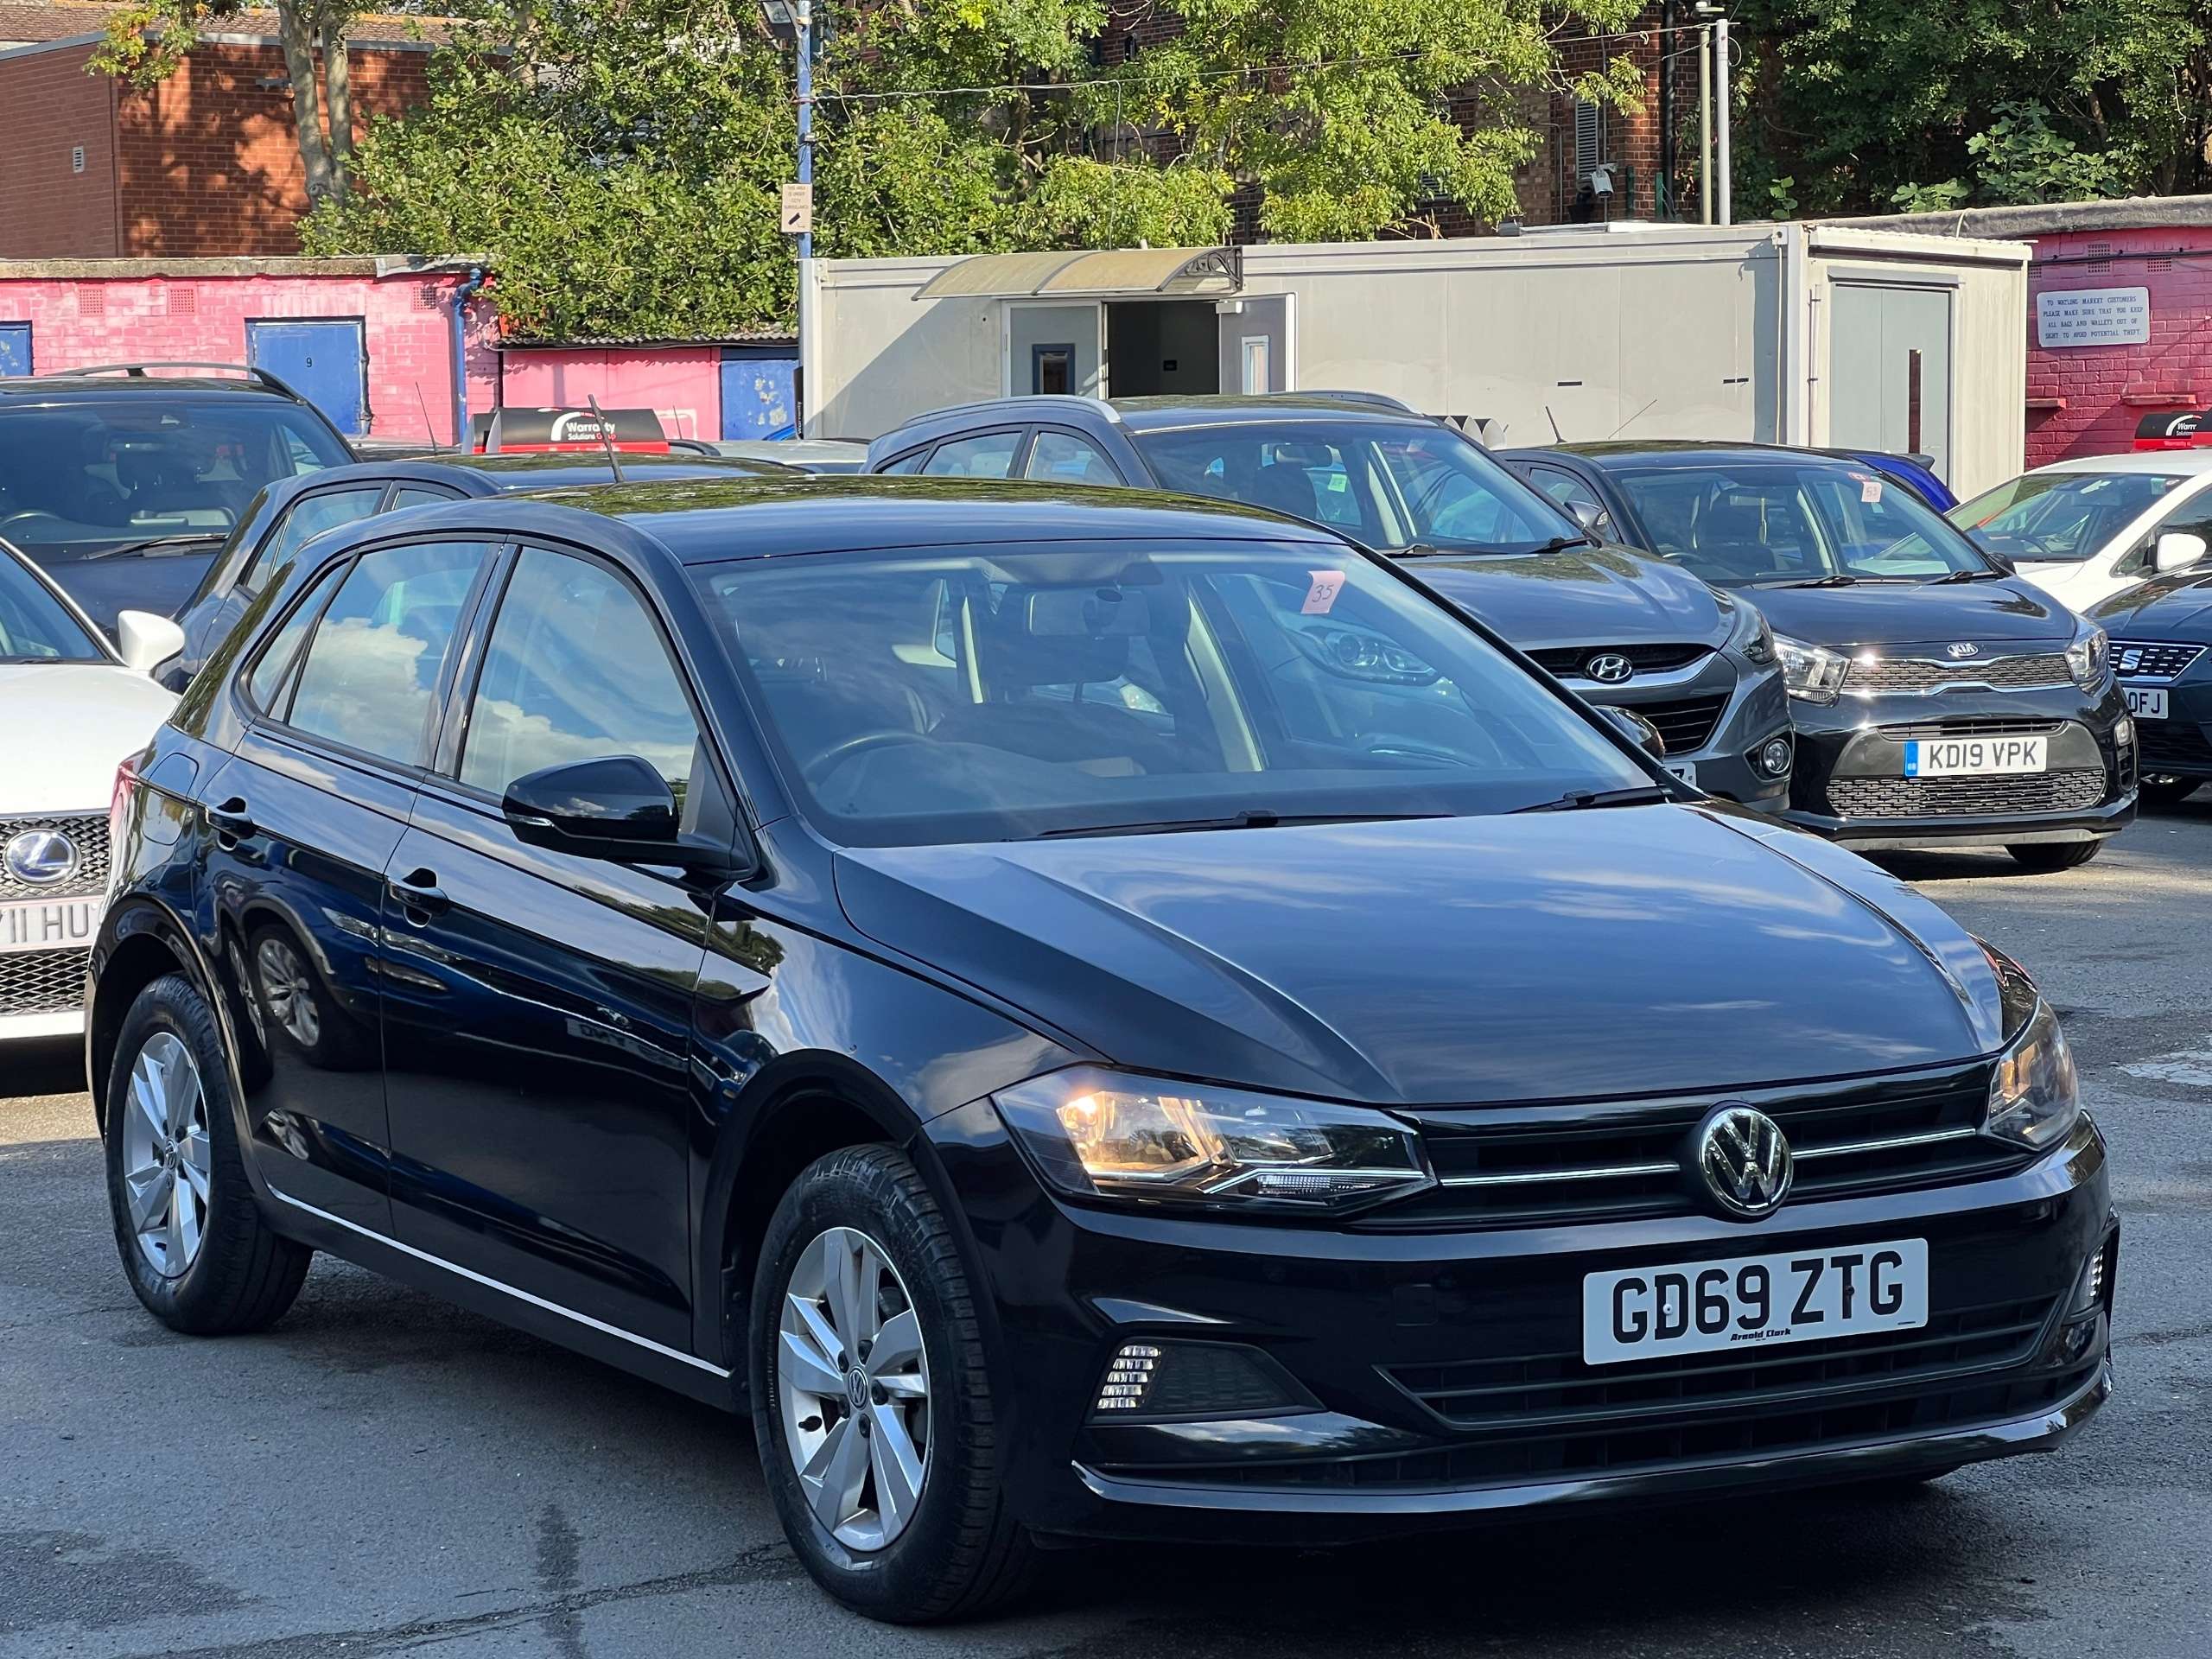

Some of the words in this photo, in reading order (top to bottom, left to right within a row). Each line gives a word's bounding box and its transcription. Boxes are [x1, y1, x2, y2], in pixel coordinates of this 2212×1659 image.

[306, 357, 313, 367] 9
[566, 422, 615, 435] Warraty
[595, 432, 616, 441] Gup
[1312, 584, 1334, 603] 35
[1929, 744, 1983, 769] KD19
[1993, 741, 2037, 766] VPK
[1612, 1264, 1770, 1344] GD69
[1790, 1250, 1903, 1325] ZTG
[1730, 1331, 1764, 1342] Arnold
[1765, 1328, 1791, 1338] Clark
